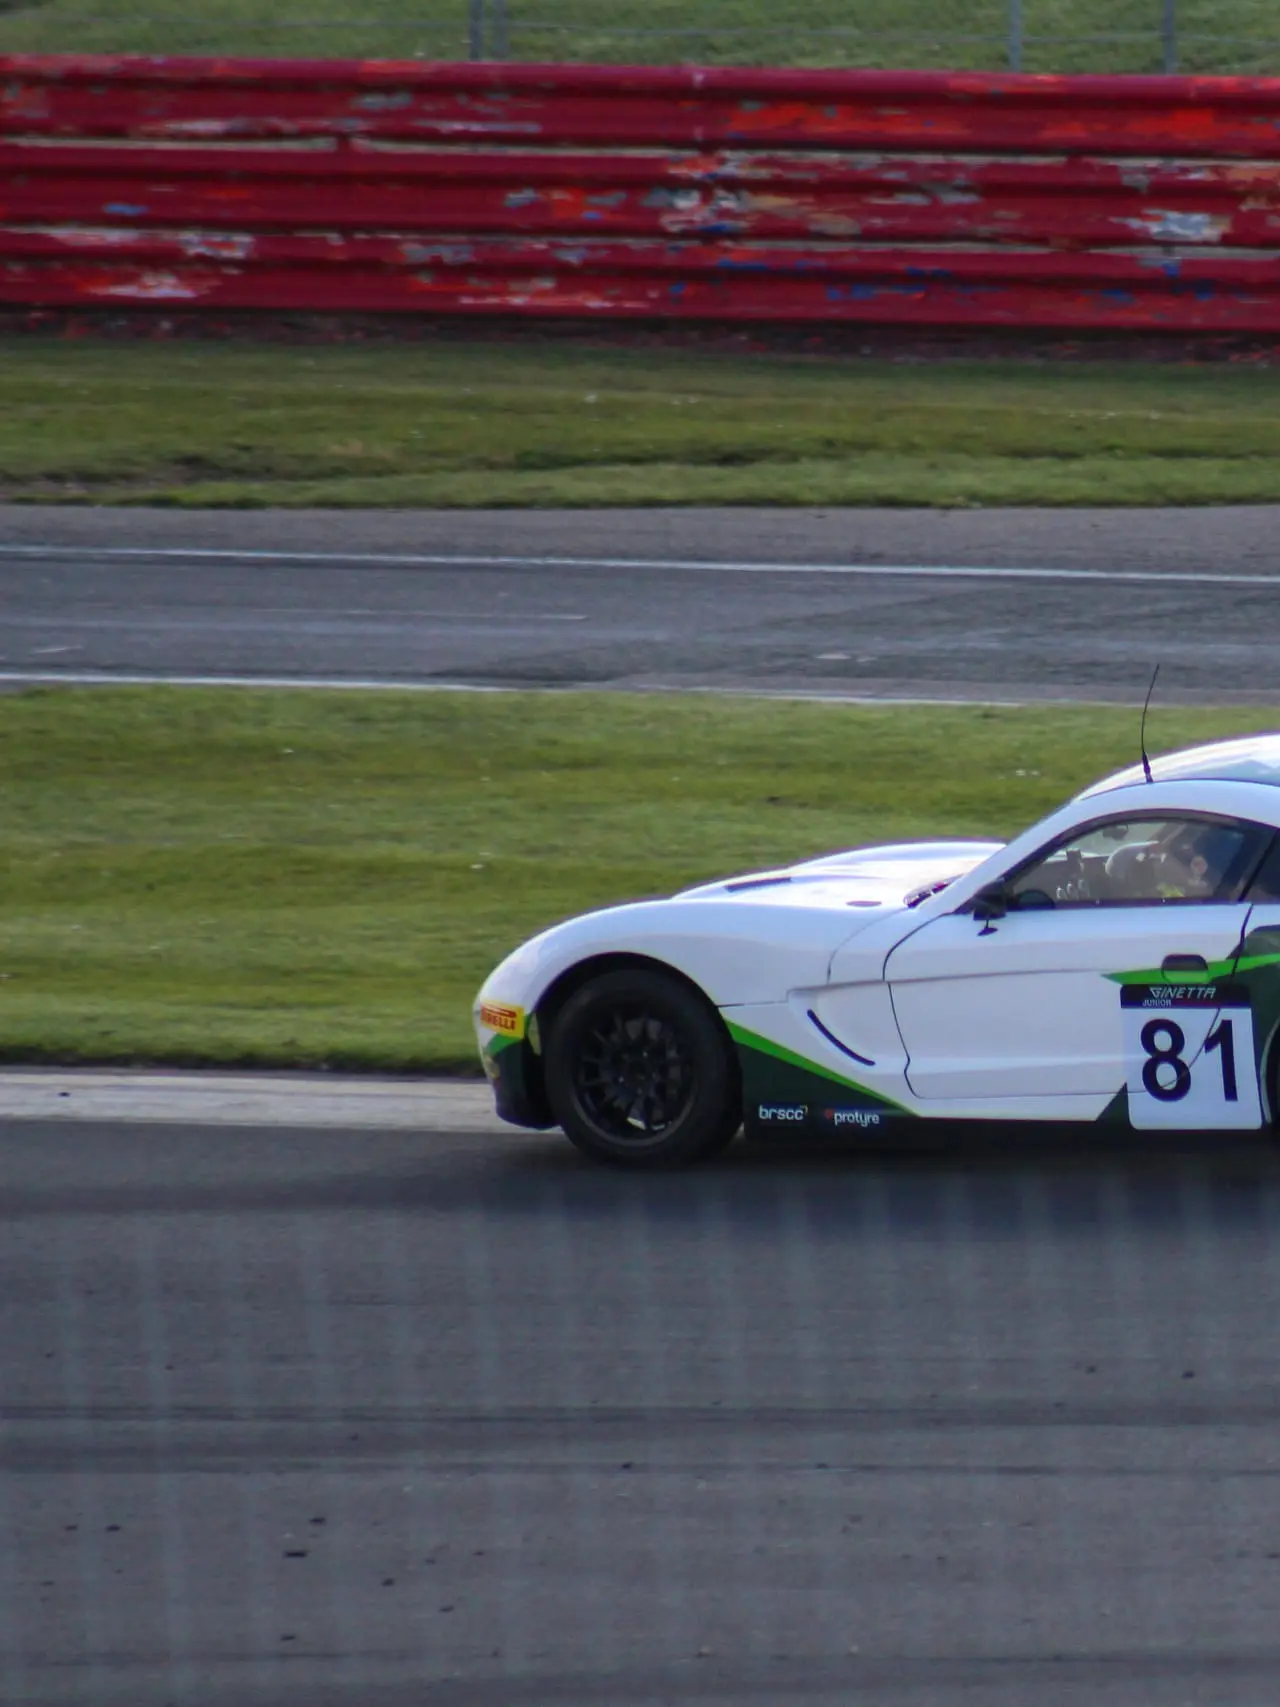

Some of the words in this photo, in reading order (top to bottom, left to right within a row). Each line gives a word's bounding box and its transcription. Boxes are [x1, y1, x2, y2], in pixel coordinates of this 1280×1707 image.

[1148, 987, 1217, 999] GINETTA
[1142, 1000, 1172, 1008] JUNIOR
[1141, 1019, 1238, 1102] 81
[759, 1105, 803, 1120] brscc
[834, 1111, 880, 1127] protyre
